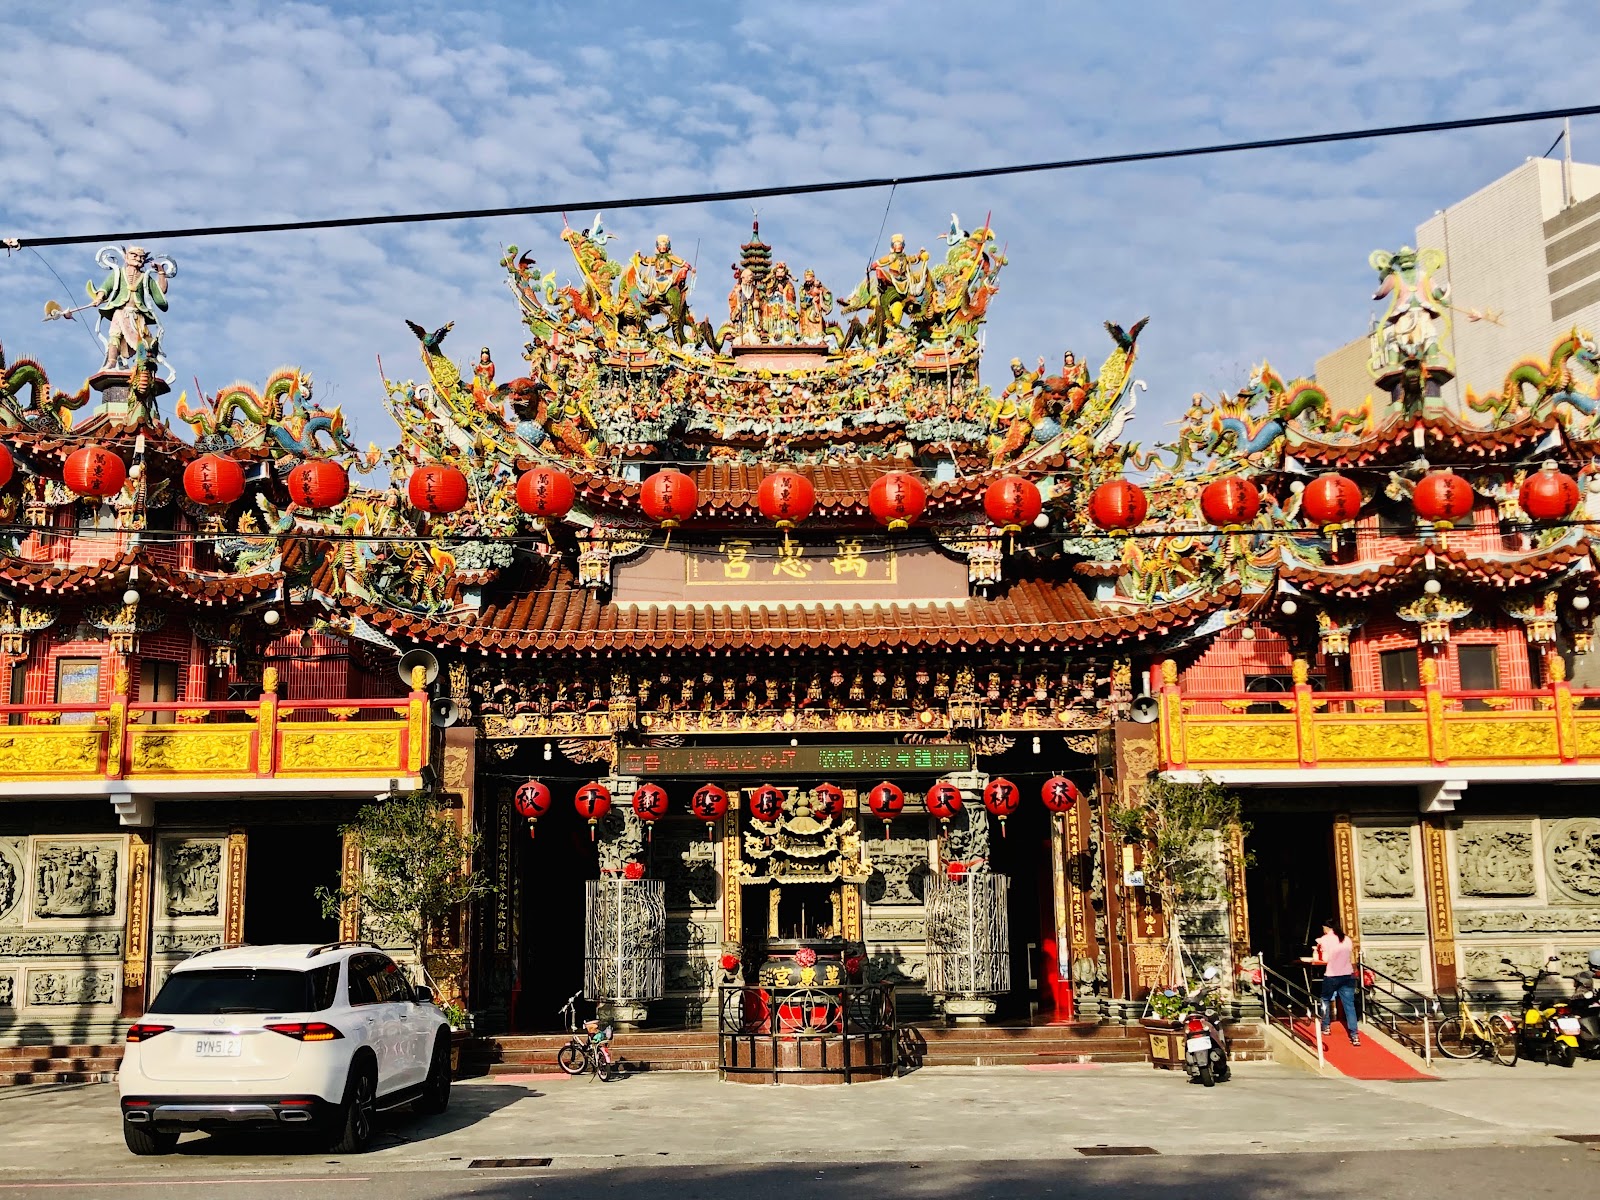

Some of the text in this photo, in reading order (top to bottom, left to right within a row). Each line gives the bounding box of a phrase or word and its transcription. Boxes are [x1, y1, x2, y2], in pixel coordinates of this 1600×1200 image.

[534, 474, 549, 511] 萬惠宮
[661, 475, 673, 513] 天上聖母
[779, 477, 793, 514] 萬惠宮
[894, 476, 908, 514] 天上聖母
